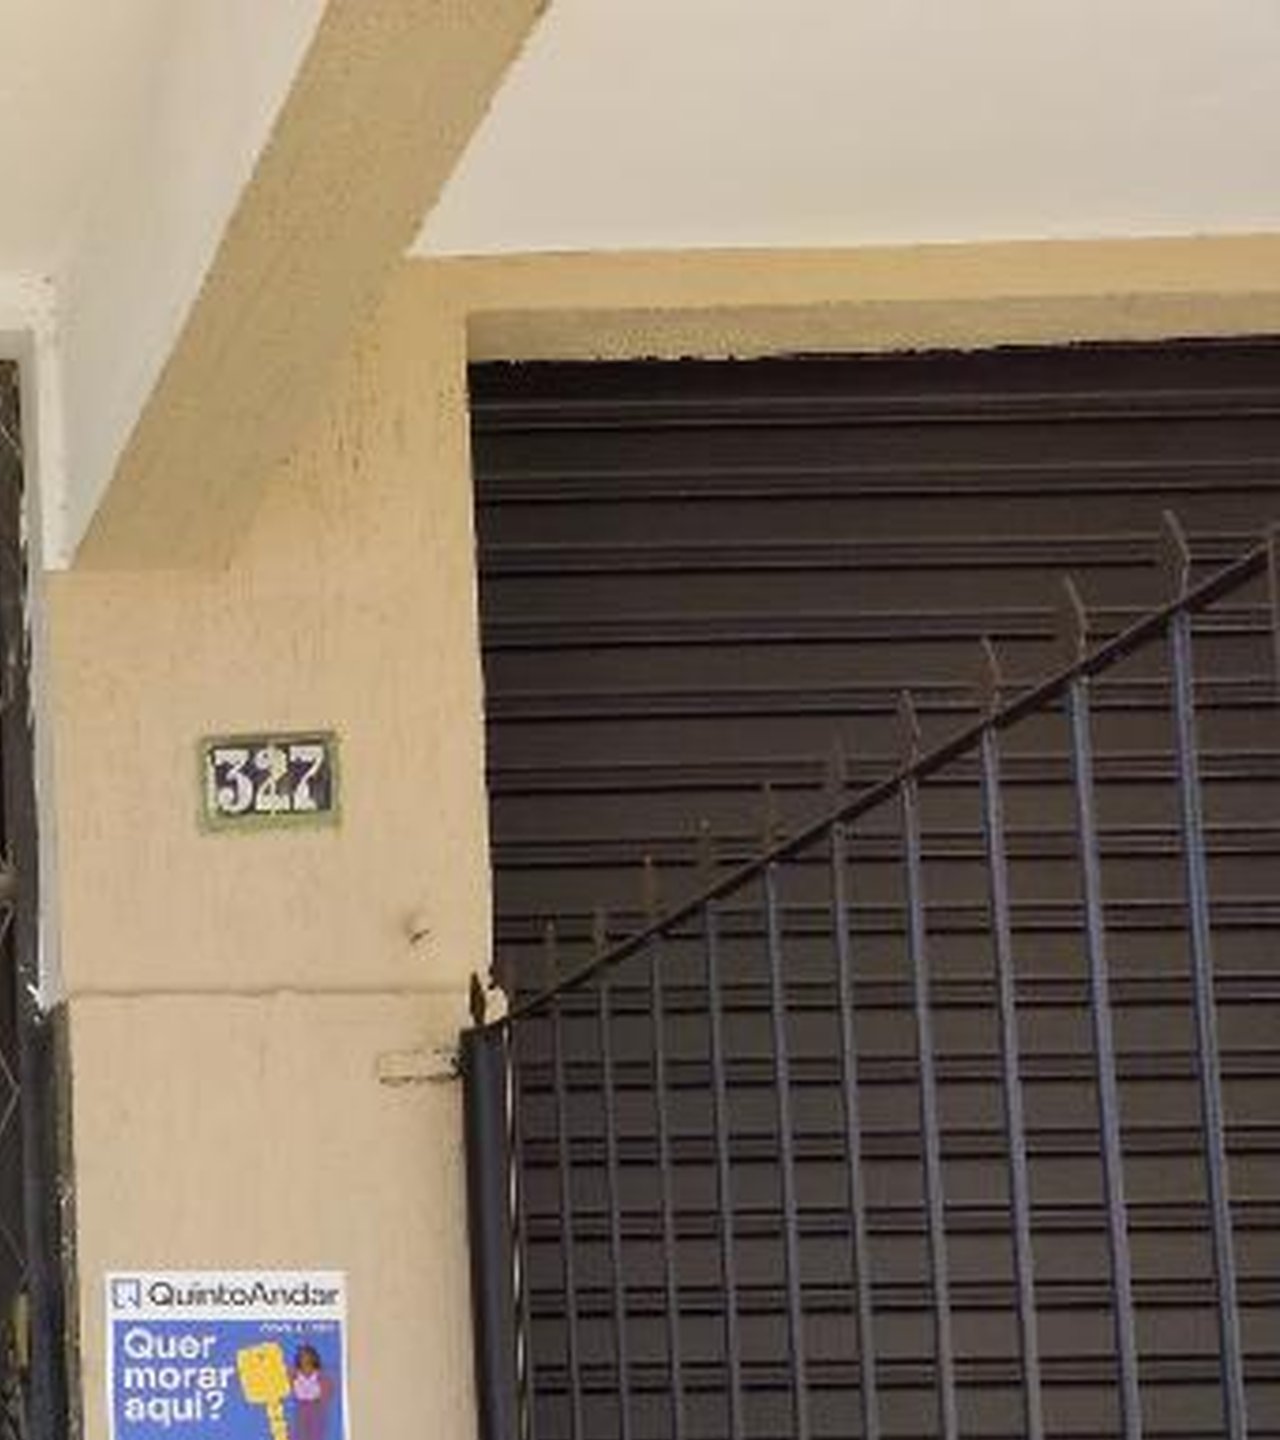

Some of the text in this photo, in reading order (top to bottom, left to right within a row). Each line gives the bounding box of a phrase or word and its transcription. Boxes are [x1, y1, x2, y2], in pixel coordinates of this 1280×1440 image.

[213, 746, 324, 813] 327
[148, 1281, 339, 1306] QuintoAndar
[124, 1328, 217, 1359] Quer
[124, 1367, 235, 1390] morar
[124, 1391, 225, 1427] aqui?
